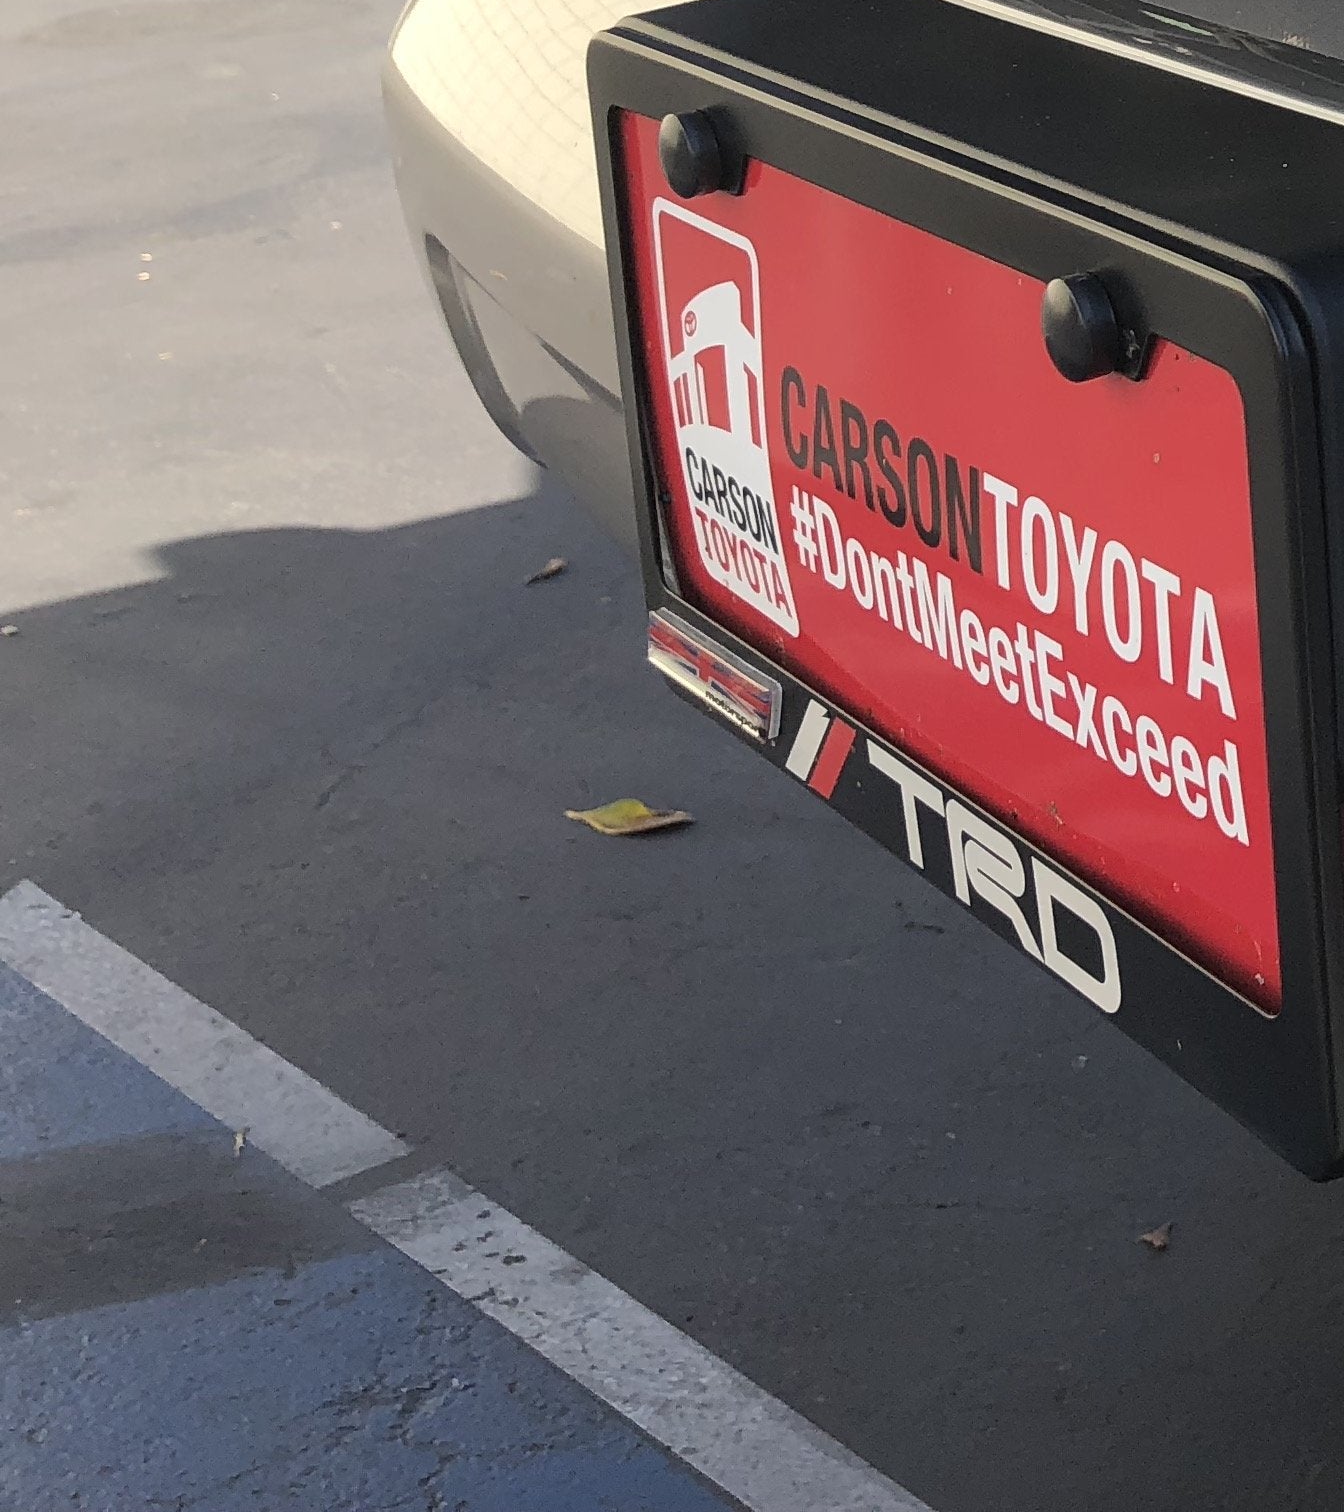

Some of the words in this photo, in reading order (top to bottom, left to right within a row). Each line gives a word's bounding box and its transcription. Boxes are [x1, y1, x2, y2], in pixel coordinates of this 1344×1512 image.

[686, 447, 780, 556] CARSON
[695, 506, 794, 619] TOYOTA
[789, 484, 1250, 847] #DontMeetExceed
[868, 738, 1122, 1014] TRD
